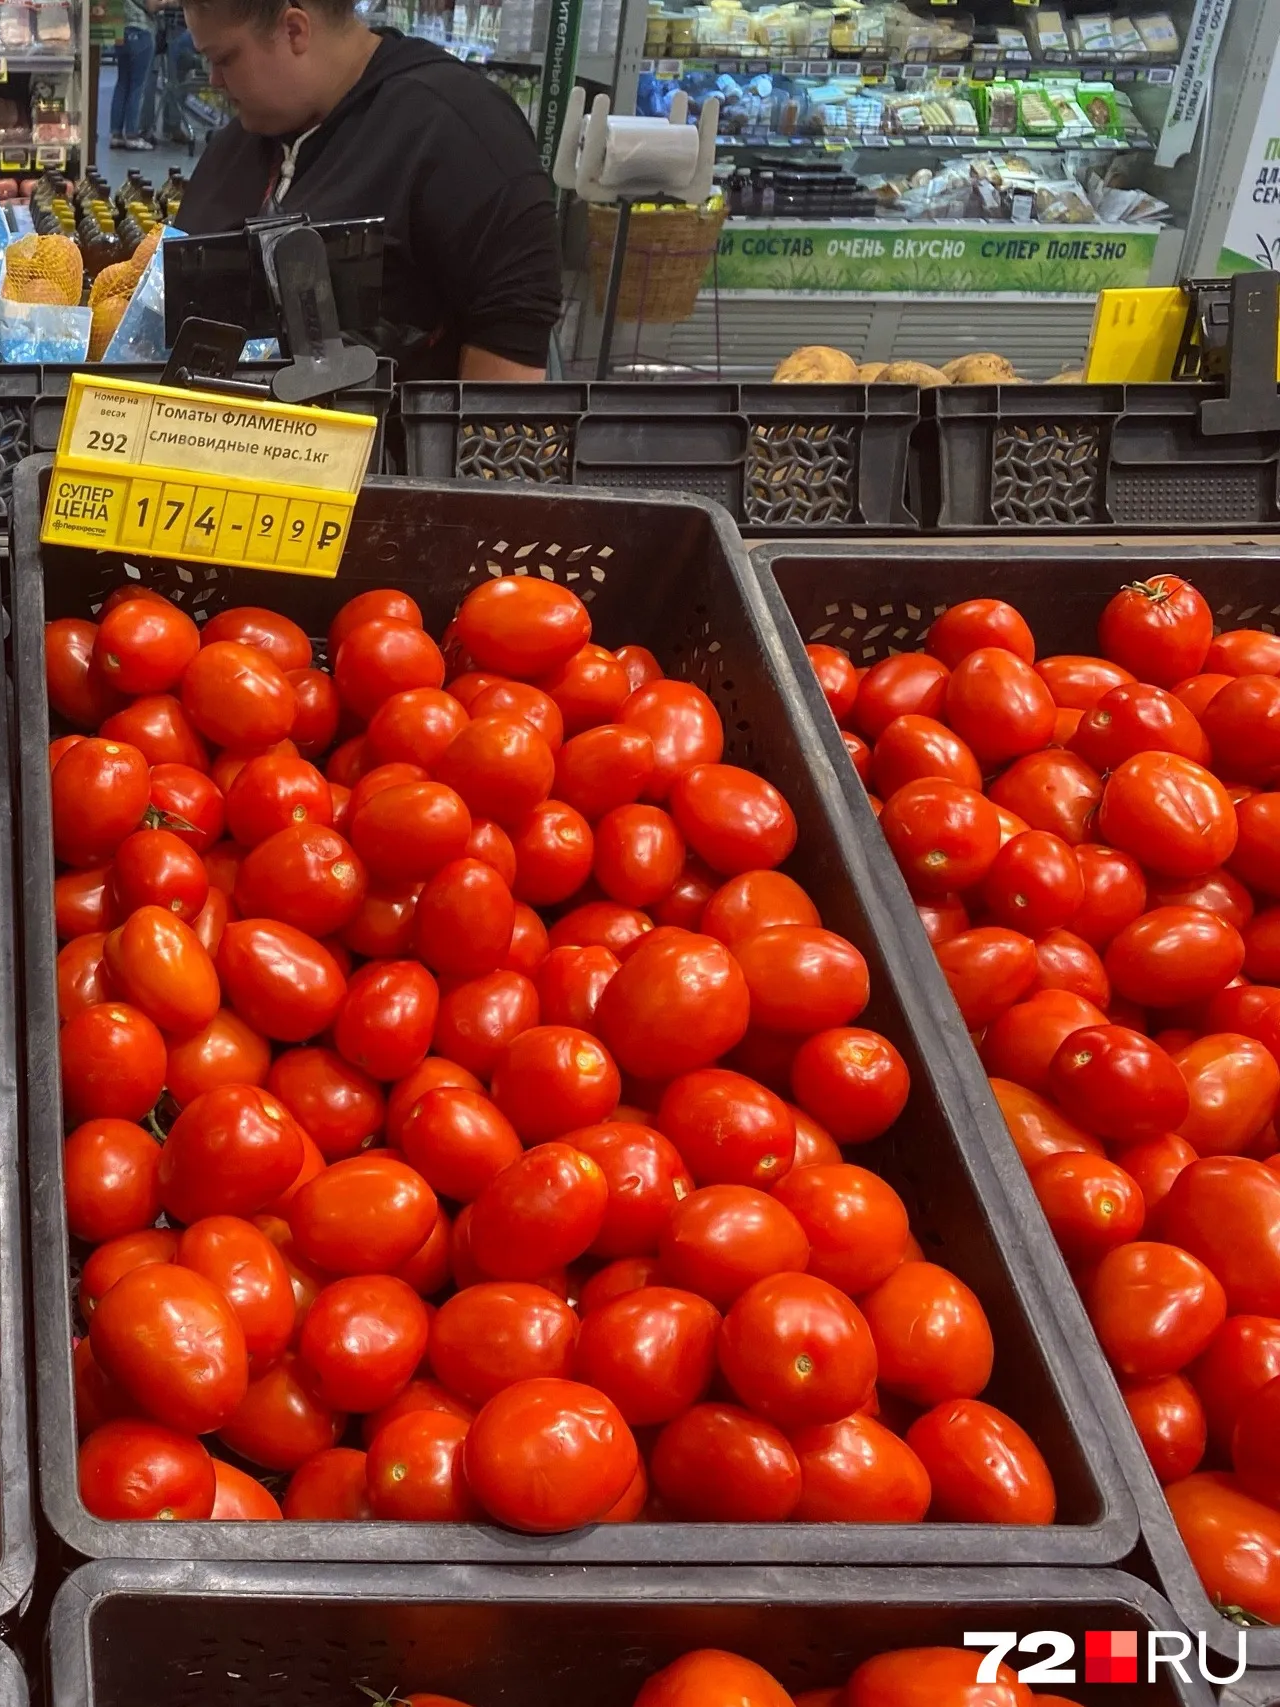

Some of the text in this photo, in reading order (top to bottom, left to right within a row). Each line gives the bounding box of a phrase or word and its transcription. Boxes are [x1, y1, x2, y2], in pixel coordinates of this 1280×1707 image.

[1184, 79, 1204, 122] ТОЛЬКО
[1264, 137, 1280, 161] П
[742, 237, 814, 257] СОСТАВ
[826, 238, 885, 257] ОЧЕНЬ
[892, 239, 966, 259] ВКУСНО
[980, 239, 1040, 260] СУПЕР
[1046, 240, 1127, 261] ПОЛЕЗНО
[94, 391, 139, 405] Номер на
[100, 408, 127, 419] весах
[155, 402, 318, 437] Томаты ФЛАМЕНКО
[86, 430, 128, 454] 292
[149, 432, 259, 454] сливовидные
[58, 482, 114, 503] СУПЕР
[54, 499, 109, 522] ЦЕНА
